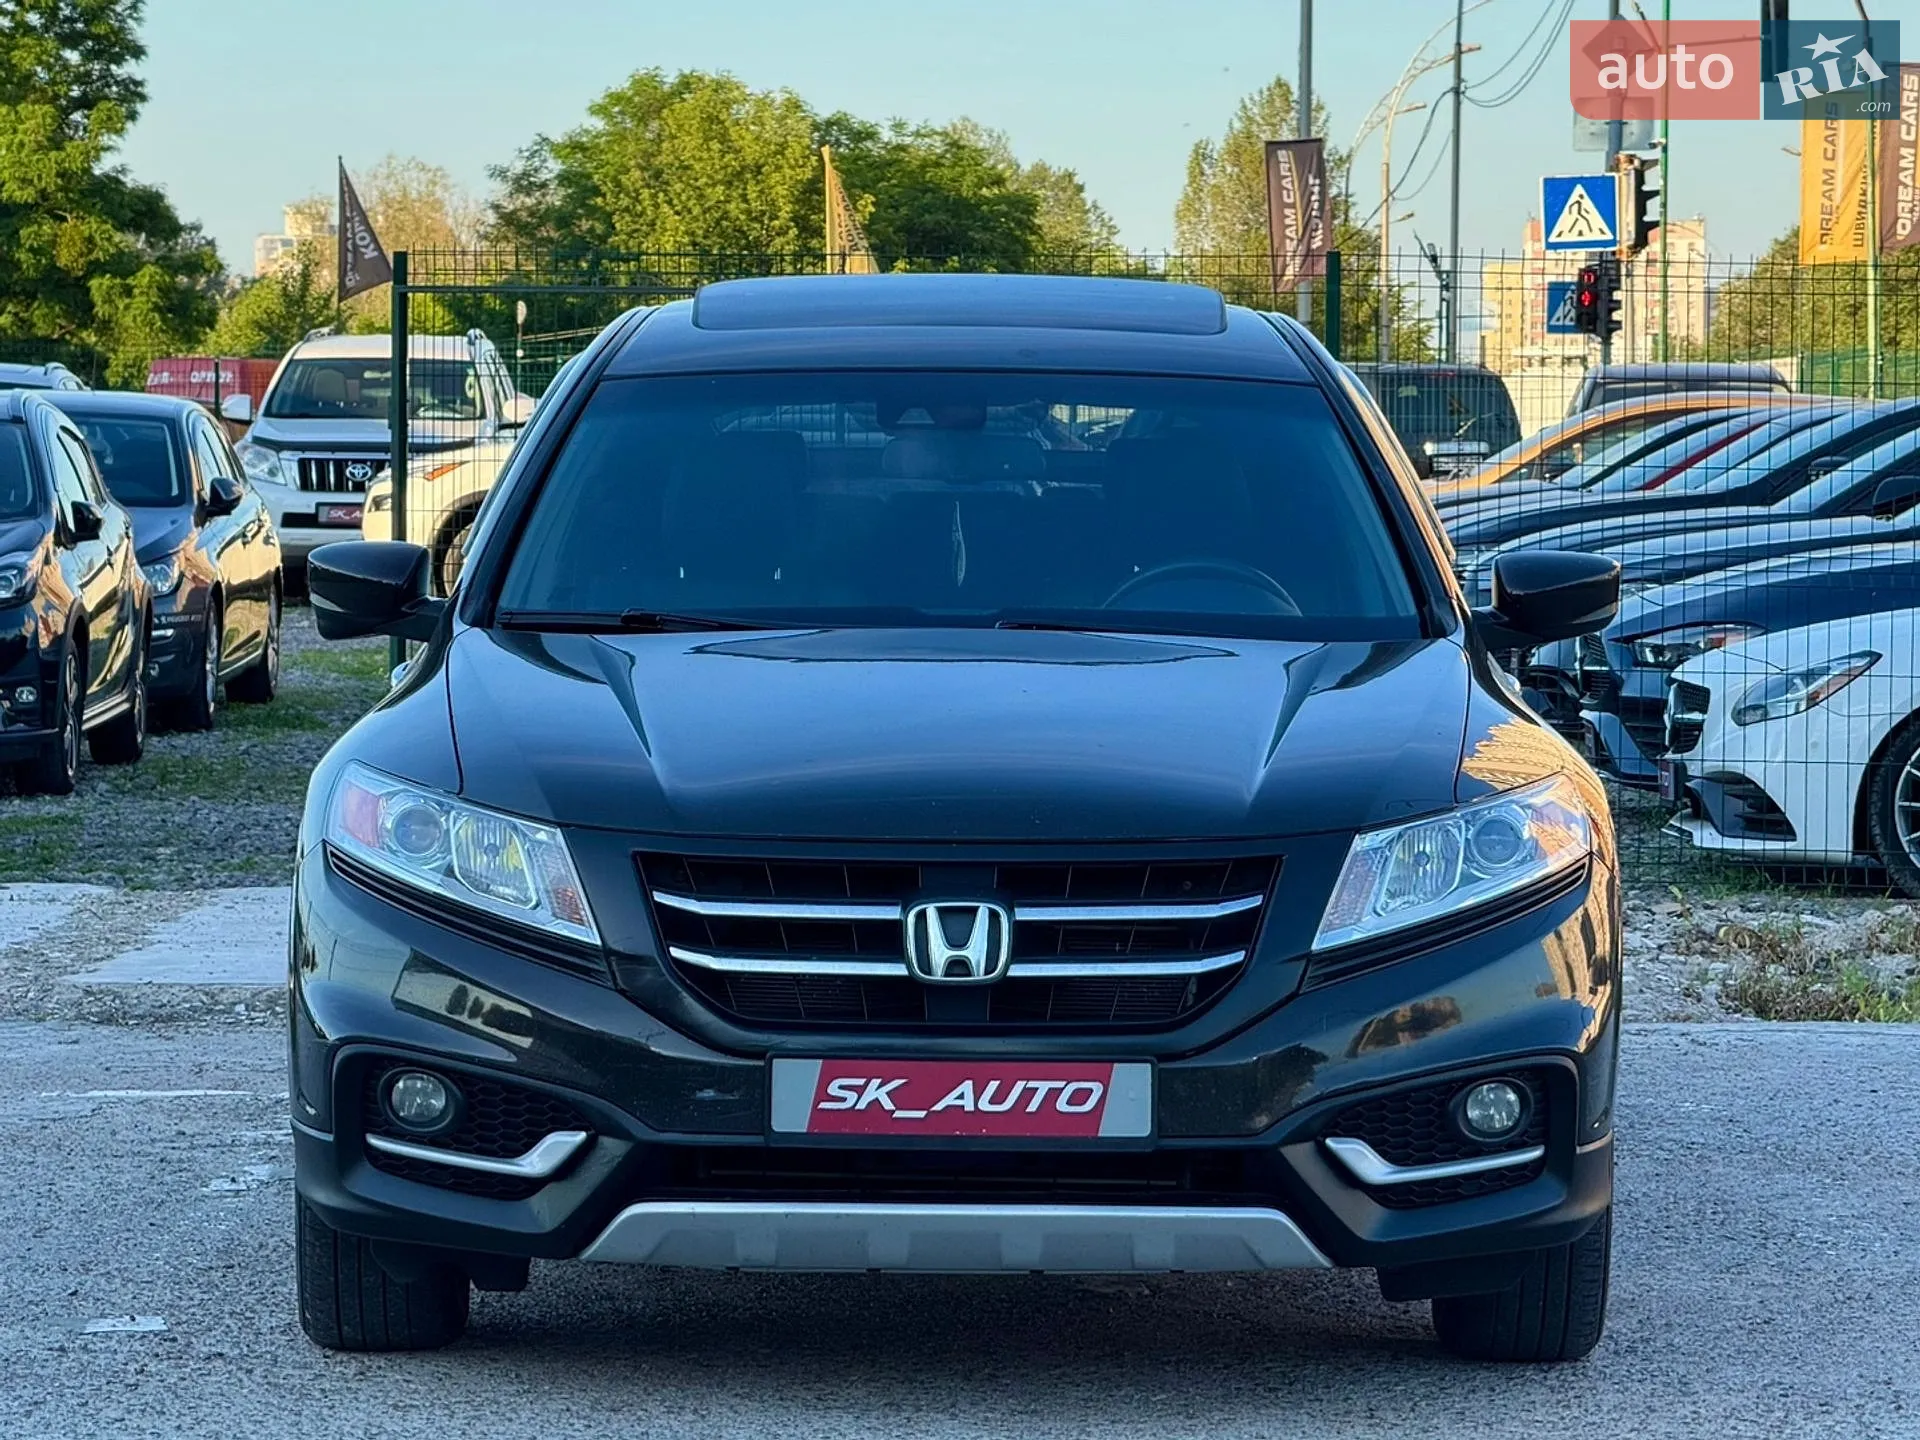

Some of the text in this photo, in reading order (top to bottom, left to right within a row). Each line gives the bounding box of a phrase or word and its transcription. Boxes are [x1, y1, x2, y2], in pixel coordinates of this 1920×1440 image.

[1822, 101, 1838, 162] CARS
[1900, 74, 1919, 141] CARS
[1896, 148, 1916, 236] DREAM
[817, 1078, 1104, 1119] SK_AUTO
